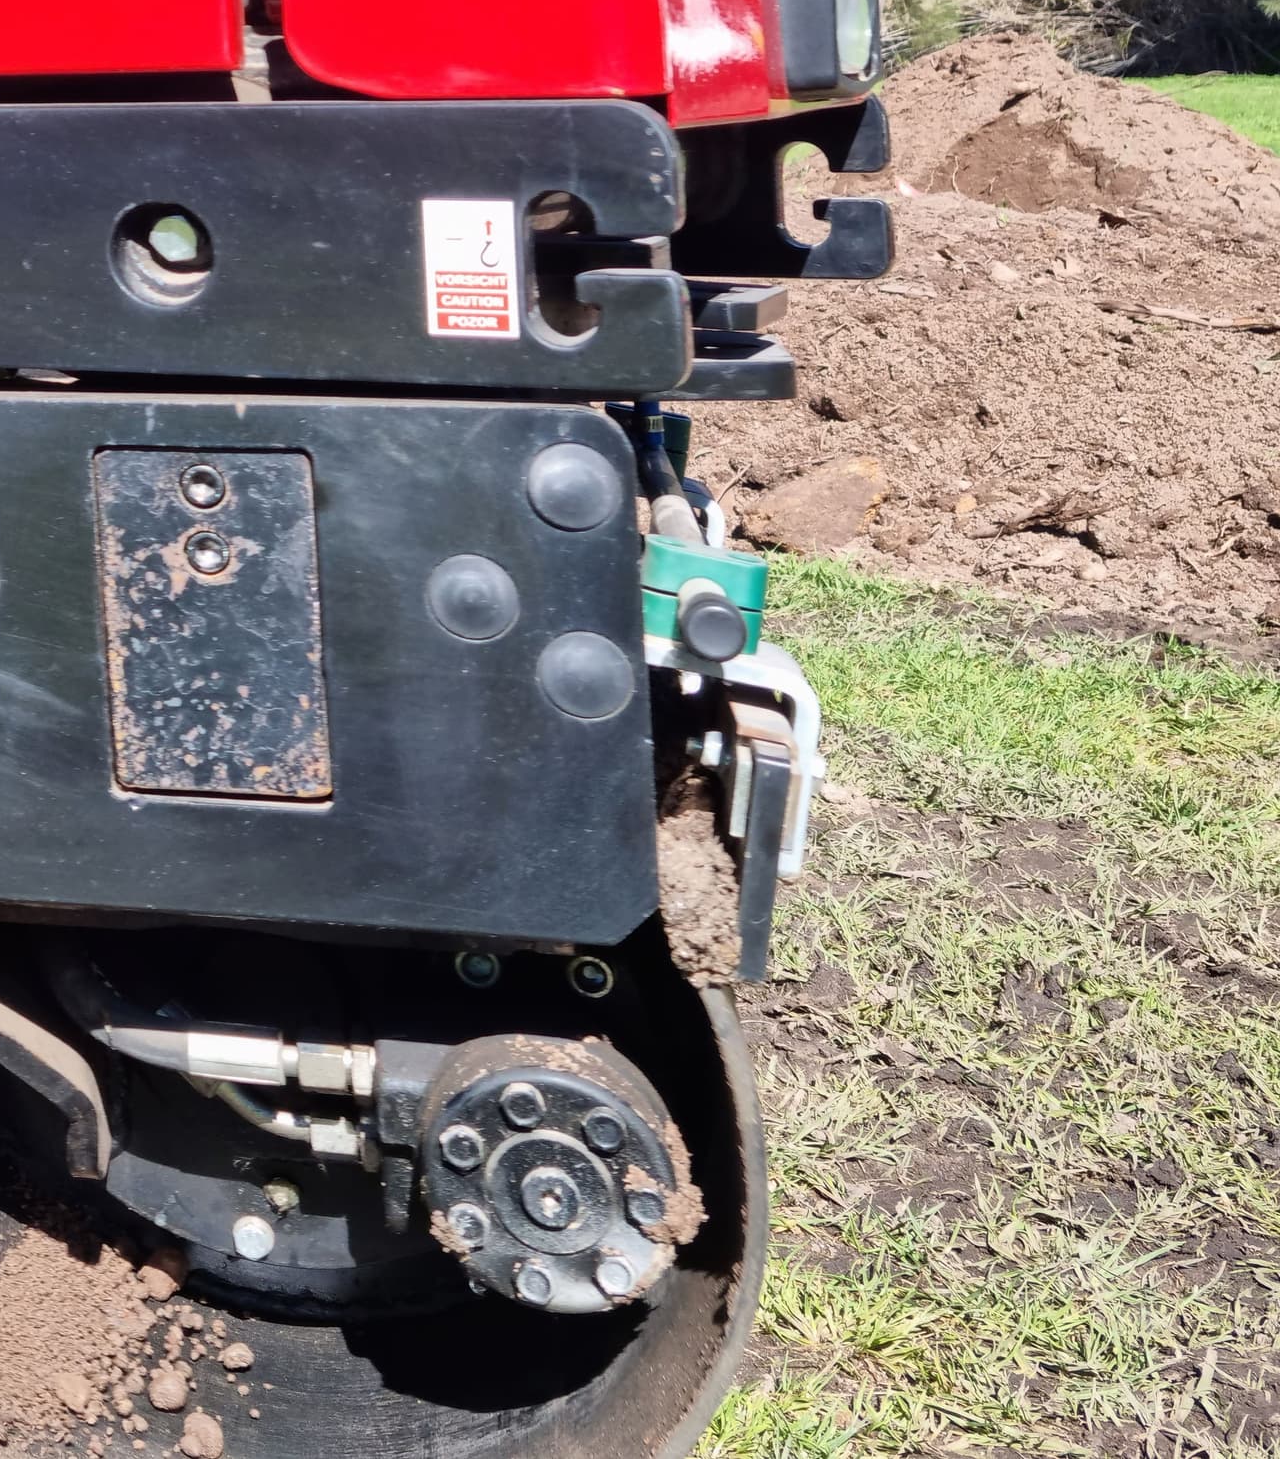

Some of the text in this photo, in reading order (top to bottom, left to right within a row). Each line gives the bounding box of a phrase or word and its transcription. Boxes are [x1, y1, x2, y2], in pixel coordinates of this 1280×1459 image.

[436, 273, 507, 288] VORSICHT
[441, 294, 505, 308] CAUTION
[447, 315, 498, 329] POZOR
